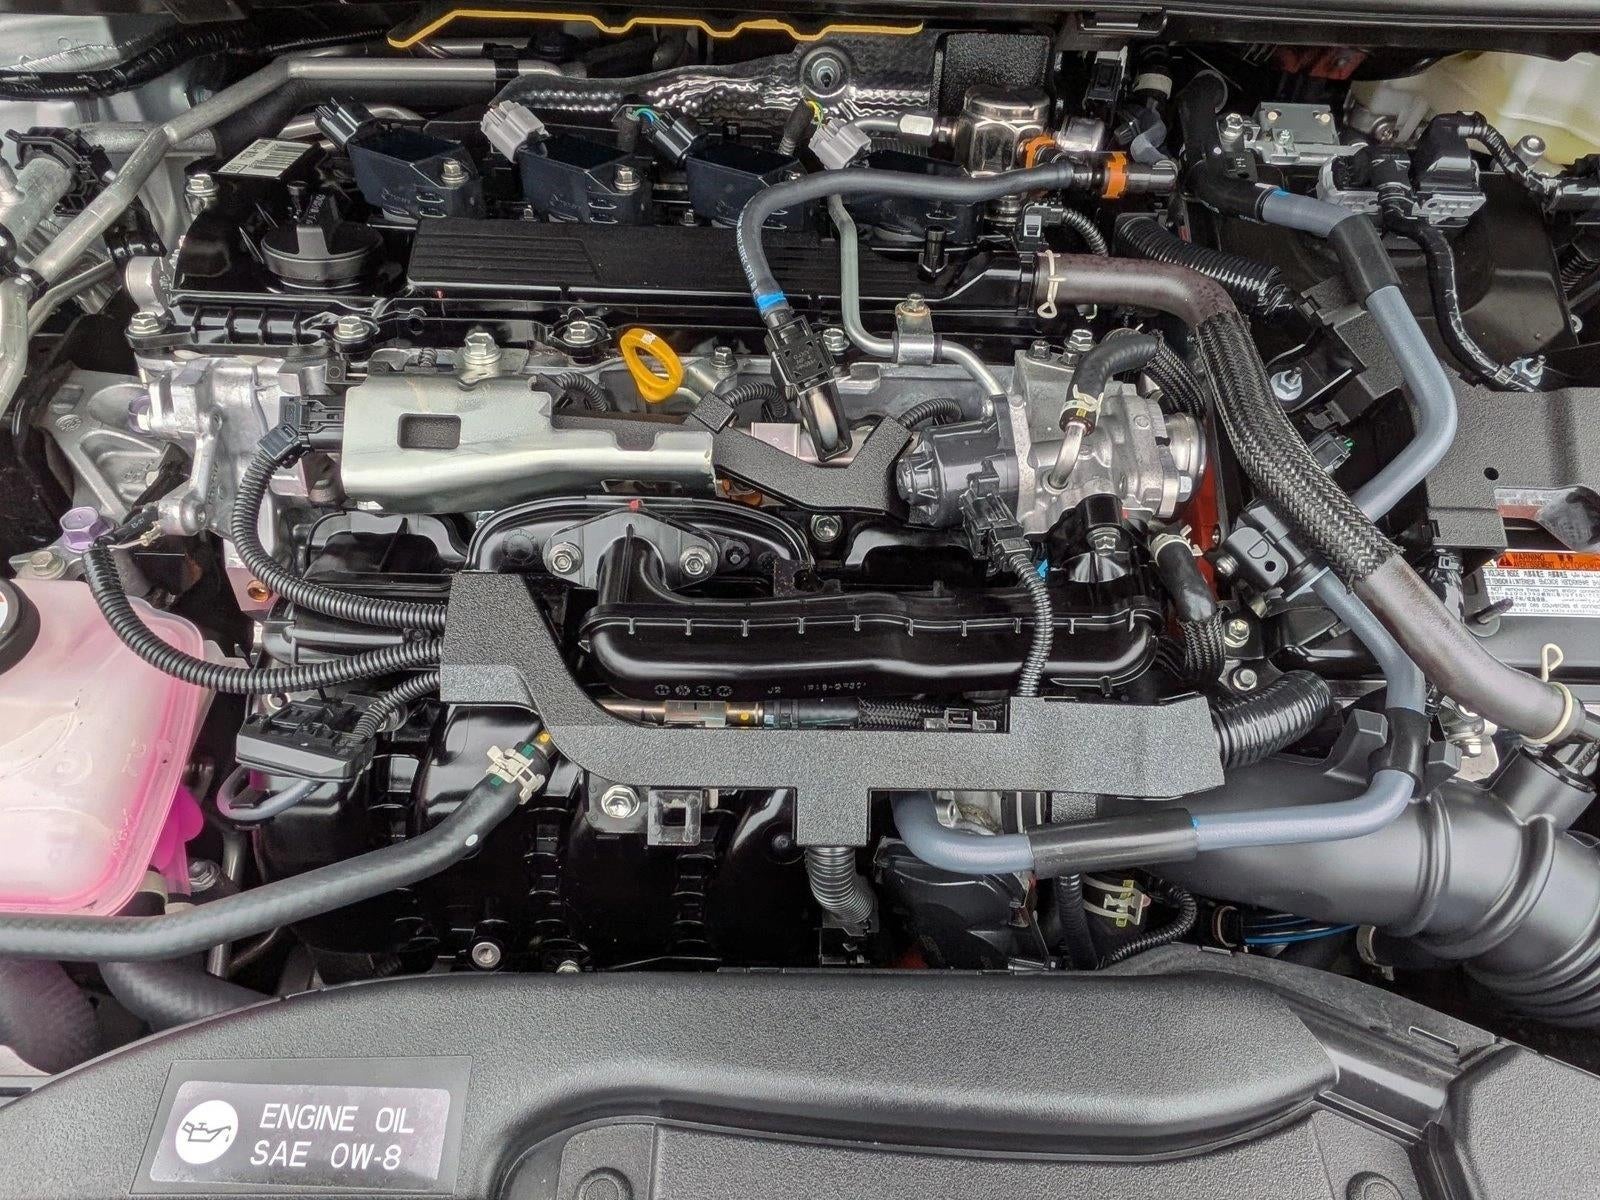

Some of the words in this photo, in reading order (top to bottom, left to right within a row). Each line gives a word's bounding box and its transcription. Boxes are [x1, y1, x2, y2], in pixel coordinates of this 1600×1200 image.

[259, 1102, 358, 1131] ENGINE
[375, 1106, 415, 1134] OIL
[250, 1139, 312, 1168] SAE
[330, 1143, 402, 1171] 0W-8
